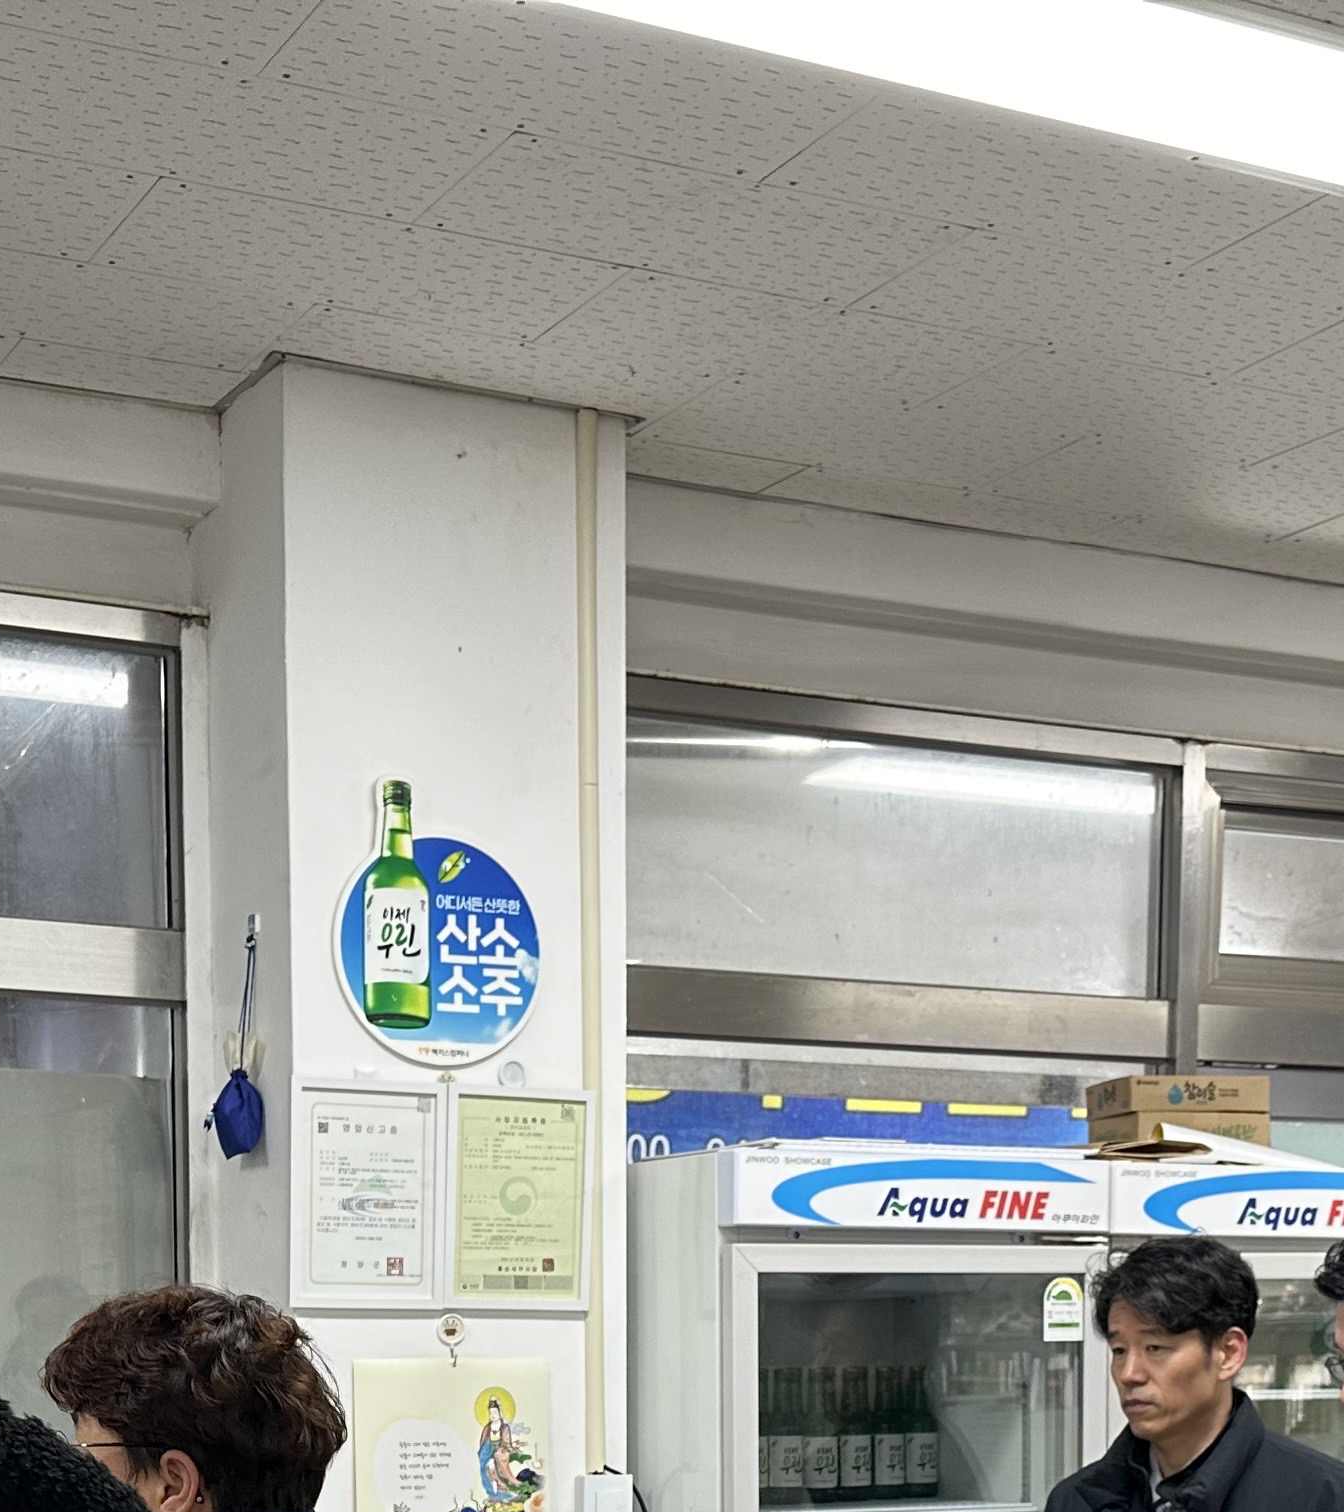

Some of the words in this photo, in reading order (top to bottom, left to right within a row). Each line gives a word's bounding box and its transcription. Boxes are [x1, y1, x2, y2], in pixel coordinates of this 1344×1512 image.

[382, 906, 411, 924] 이제
[436, 894, 483, 913] 어디서든
[484, 898, 521, 915] 산뜻한
[377, 922, 421, 959] 우린
[436, 913, 522, 966] 산소
[436, 965, 524, 1016] 소주
[876, 1187, 970, 1223] Aqua
[978, 1190, 1051, 1220] FINE
[1236, 1197, 1318, 1230] Aqua
